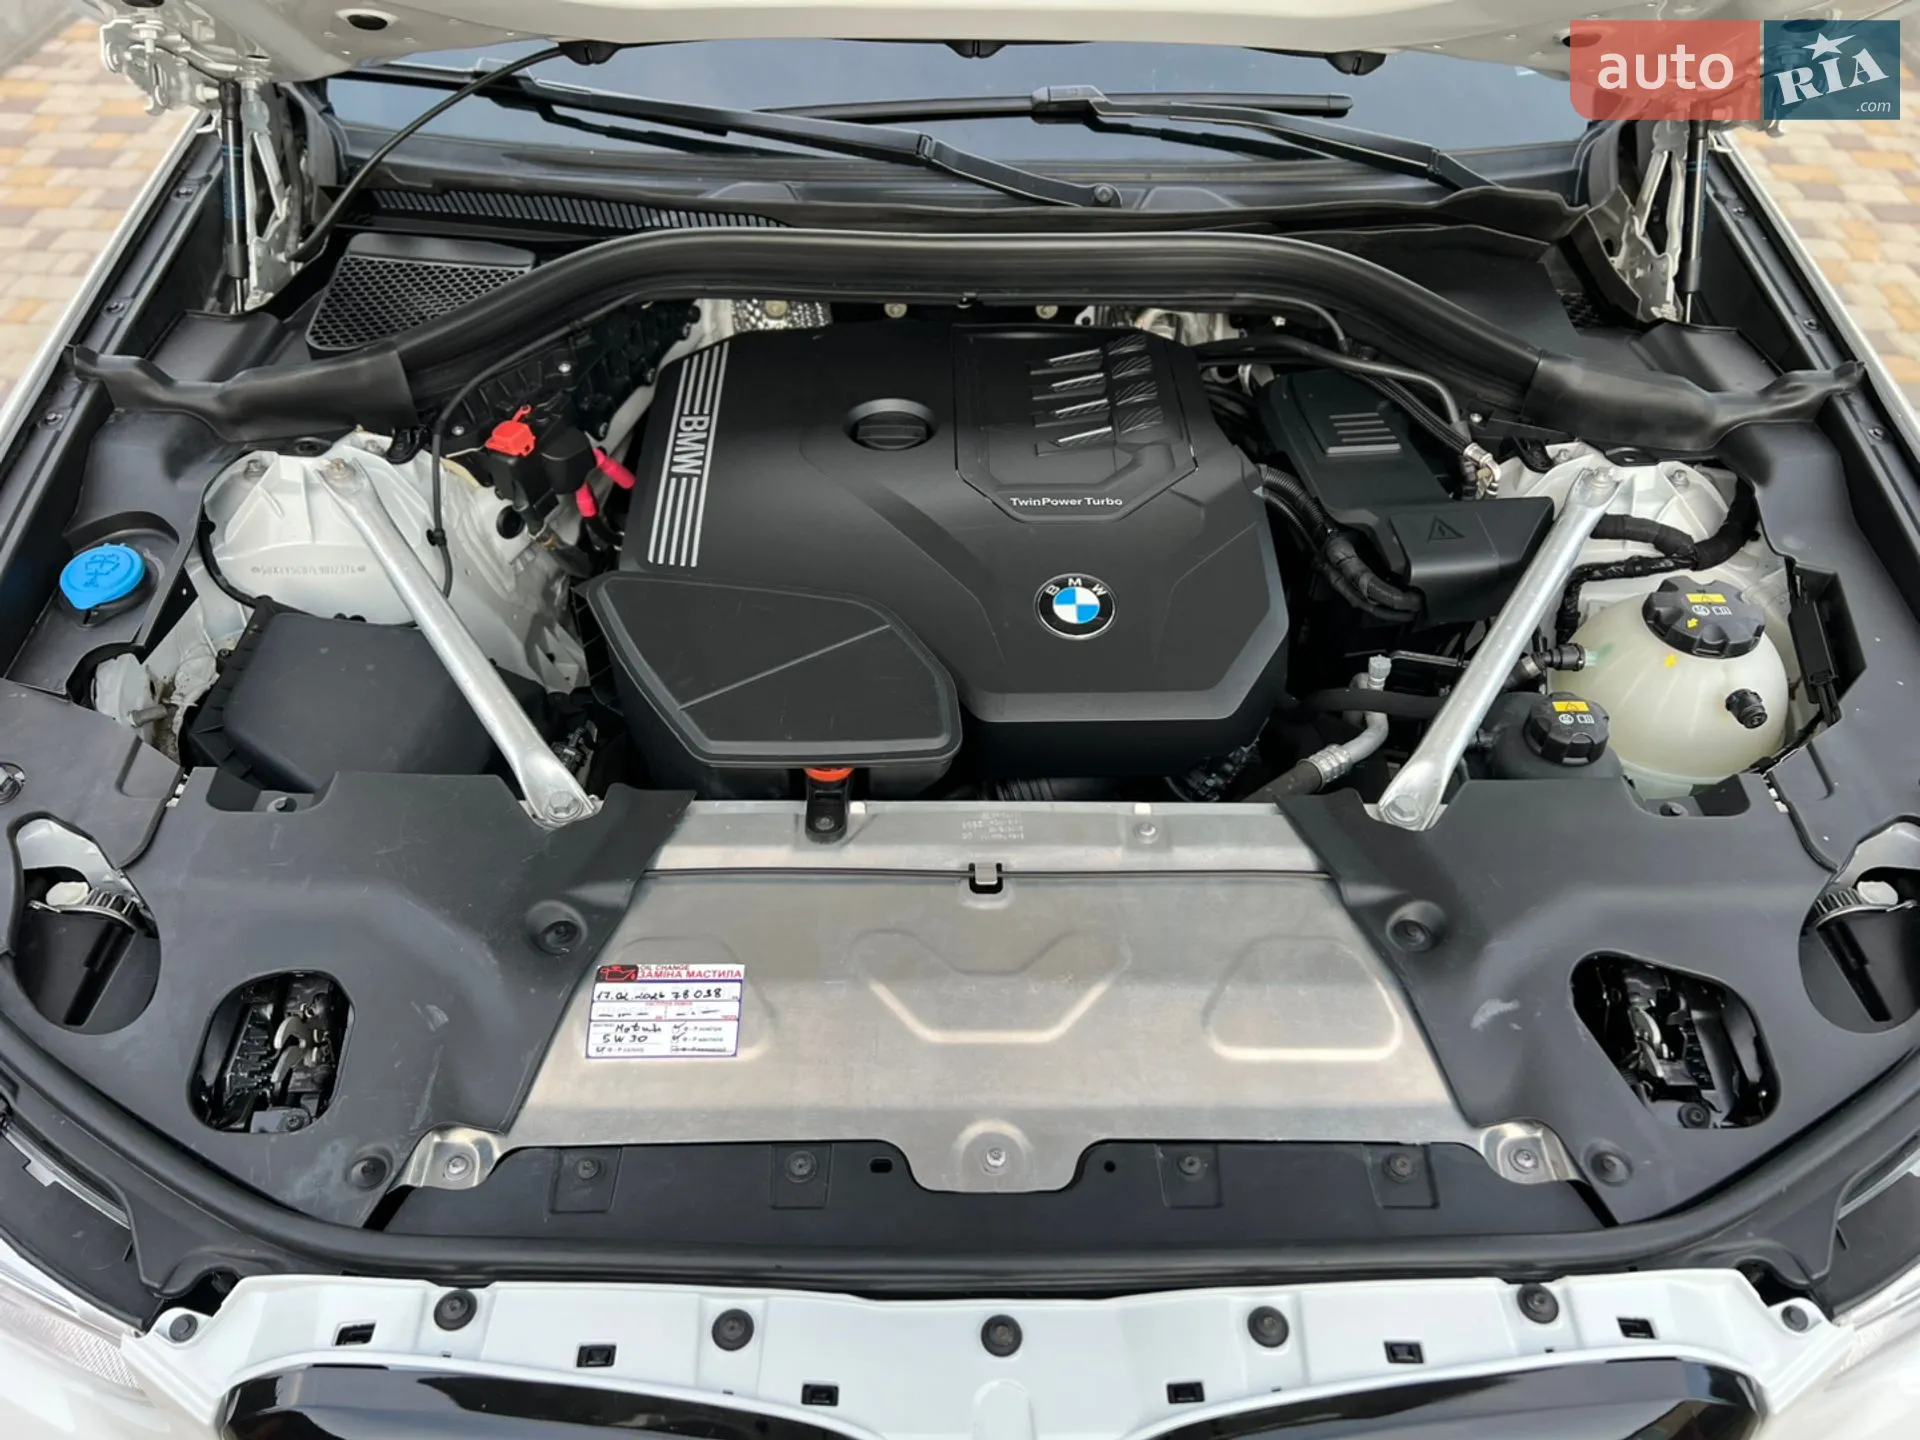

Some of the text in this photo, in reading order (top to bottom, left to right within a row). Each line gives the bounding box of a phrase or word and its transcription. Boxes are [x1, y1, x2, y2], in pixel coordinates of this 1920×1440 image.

[671, 415, 711, 475] BMW
[1010, 497, 1123, 506] TwinPower Turbo
[1045, 577, 1108, 597] BMW
[638, 969, 742, 979] ЗАМІНА МАСТИЛА
